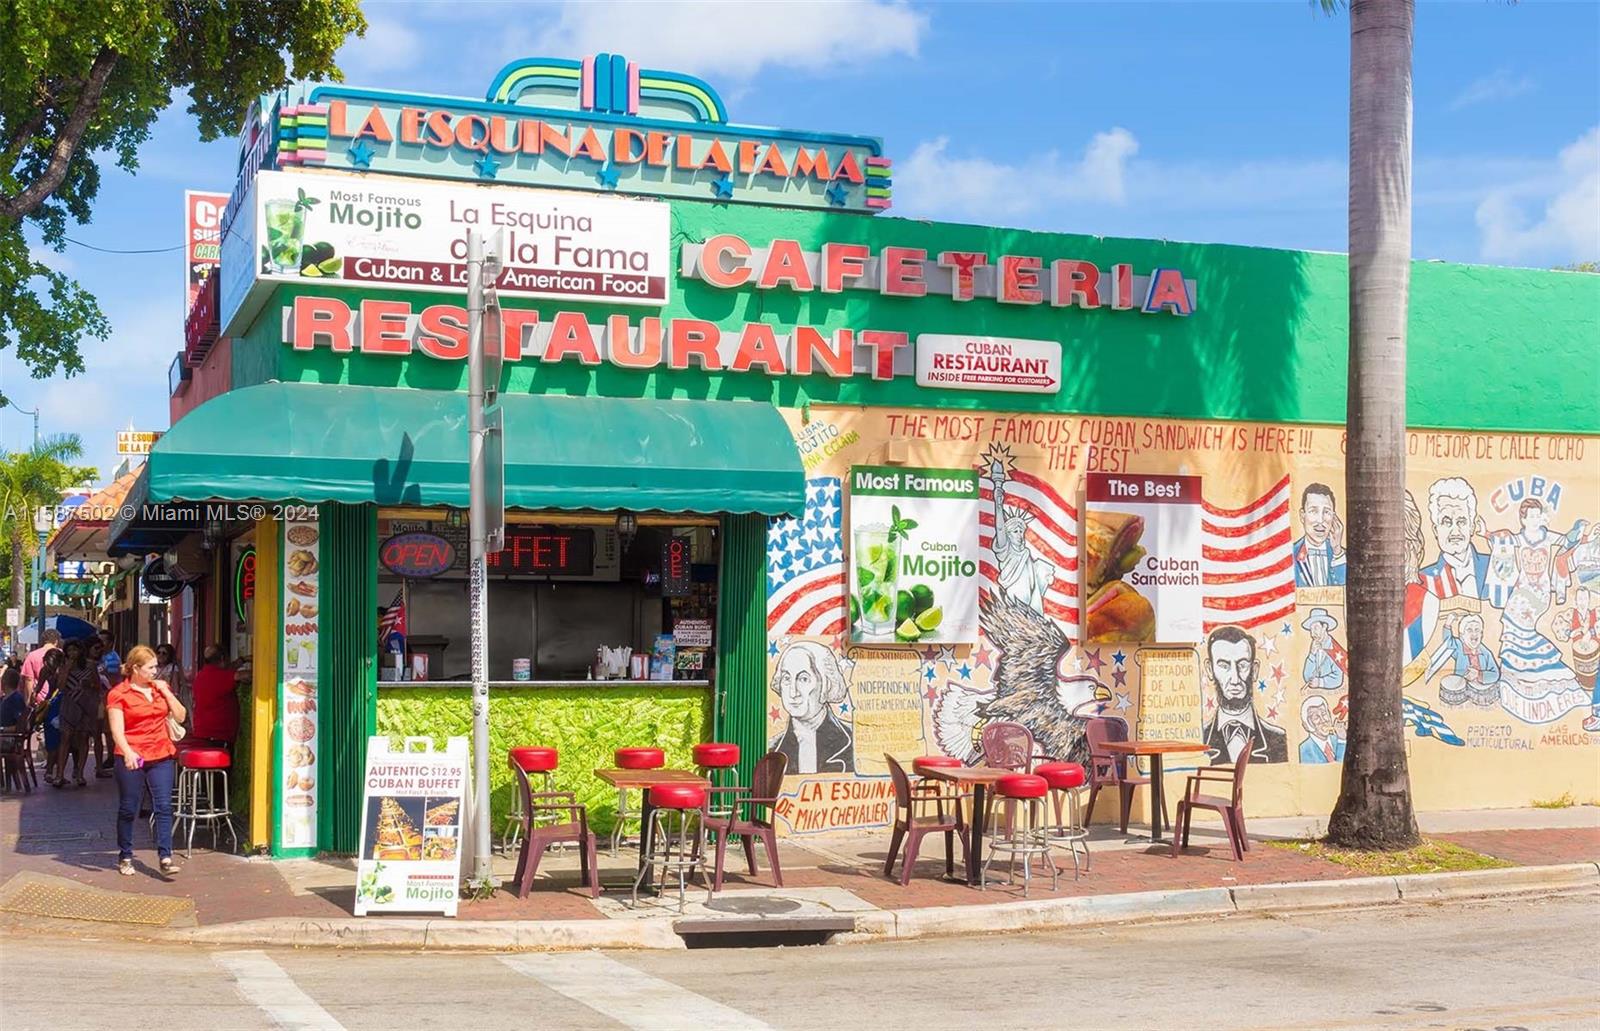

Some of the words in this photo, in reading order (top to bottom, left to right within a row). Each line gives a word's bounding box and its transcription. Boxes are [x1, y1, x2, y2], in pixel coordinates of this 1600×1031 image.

[329, 100, 393, 142] LA
[401, 106, 607, 161] ESQUINA
[613, 127, 671, 167] DE
[676, 134, 733, 172] LA
[738, 140, 865, 184] FAMA
[330, 190, 363, 202] Most
[368, 193, 422, 206] Famous
[329, 202, 422, 232] Mojito
[449, 200, 478, 224] La
[492, 203, 593, 233] Esquina
[510, 231, 538, 264] la
[554, 235, 649, 272] Fama
[354, 258, 424, 281] Cuban
[430, 266, 443, 282] &
[503, 268, 598, 291] American
[602, 273, 649, 295] Food
[699, 234, 1195, 316] CAFETERIA
[293, 296, 909, 380] RESTAURANT
[965, 342, 1012, 356] CUBAN
[933, 353, 1049, 374] RESTAURANT
[927, 372, 961, 382] INSIDE
[963, 374, 977, 382] FREE
[977, 375, 1004, 383] PARKING
[1017, 377, 1050, 385] CUSTOMERS
[119, 432, 129, 442] LA
[797, 419, 824, 440] UBAN
[886, 415, 928, 438] THE
[934, 416, 985, 442] MOST
[991, 418, 1071, 445] FAMOUS
[1078, 419, 1136, 447] CUBAN
[1142, 423, 1223, 450] SANDWICH
[1232, 428, 1247, 450] IS
[119, 443, 129, 452] DE
[131, 443, 141, 452] LA
[1425, 434, 1471, 459] MEJOR
[1476, 436, 1494, 460] DE
[1499, 435, 1541, 460] CALLE
[1547, 437, 1585, 461] OCHO
[856, 472, 900, 490] Most
[904, 474, 974, 493] Famous
[1108, 479, 1139, 496] The
[1144, 480, 1181, 498] Best
[1491, 477, 1562, 513] CUBA
[383, 543, 449, 567] OPEN
[921, 541, 957, 552] Cuban
[902, 554, 976, 582] Mojito
[1146, 557, 1199, 571] Cuban
[1131, 572, 1199, 586] Sandwich
[1151, 680, 1164, 692] DE
[1171, 680, 1186, 692] LA
[1142, 693, 1200, 708] ESCLAVITUD
[1179, 712, 1192, 723] NO
[1164, 728, 1200, 740] ESCLAVO
[1467, 725, 1512, 738] PROYECTO
[1540, 732, 1590, 747] AMERICAS
[1467, 738, 1534, 751] MULTICULTURAL
[369, 766, 429, 776] AUTENTIC
[431, 767, 461, 777] $12.95
[368, 778, 414, 788] CUBAN
[418, 779, 461, 788] BUFFET
[800, 783, 823, 802] LA
[831, 781, 897, 801] ESQUINA
[775, 797, 795, 819] DE
[794, 807, 829, 830] MIKY
[829, 802, 889, 827] CHEVALIER
[406, 887, 454, 902] Mojito
